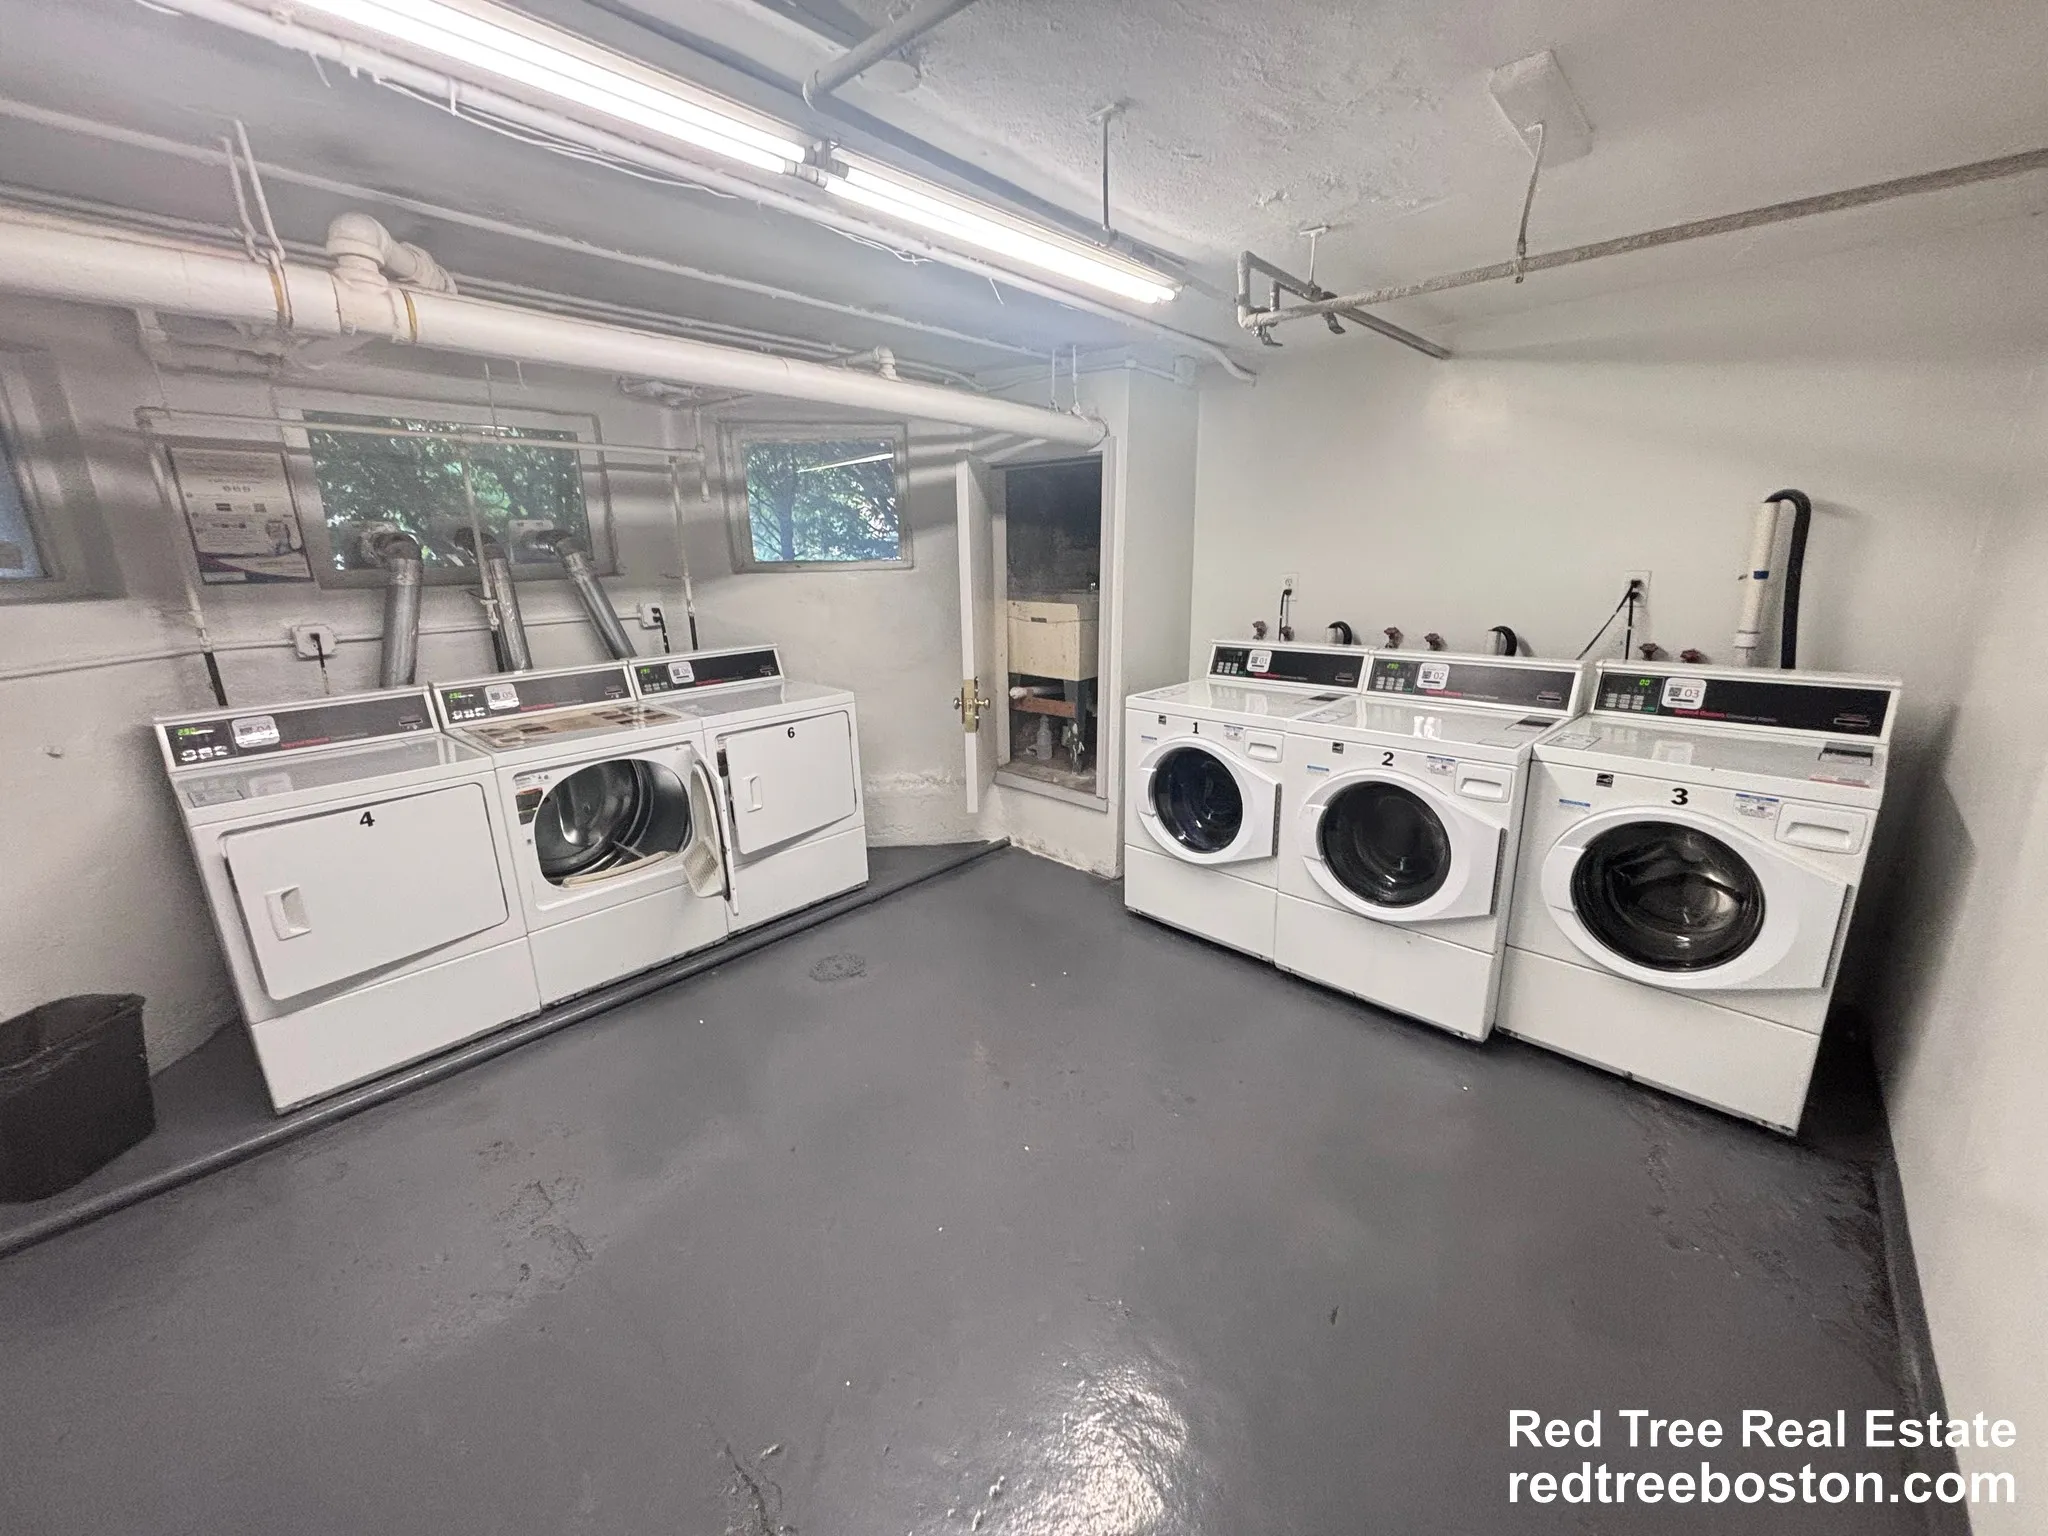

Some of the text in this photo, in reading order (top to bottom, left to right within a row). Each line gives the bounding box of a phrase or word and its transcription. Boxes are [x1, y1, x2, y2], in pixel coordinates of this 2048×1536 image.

[1433, 671, 1445, 680] 02
[1684, 688, 1700, 698] 03
[787, 726, 796, 739] 6
[1191, 721, 1200, 735] 1
[1381, 751, 1394, 767] 2
[1671, 787, 1689, 806] 3
[359, 811, 376, 827] 4
